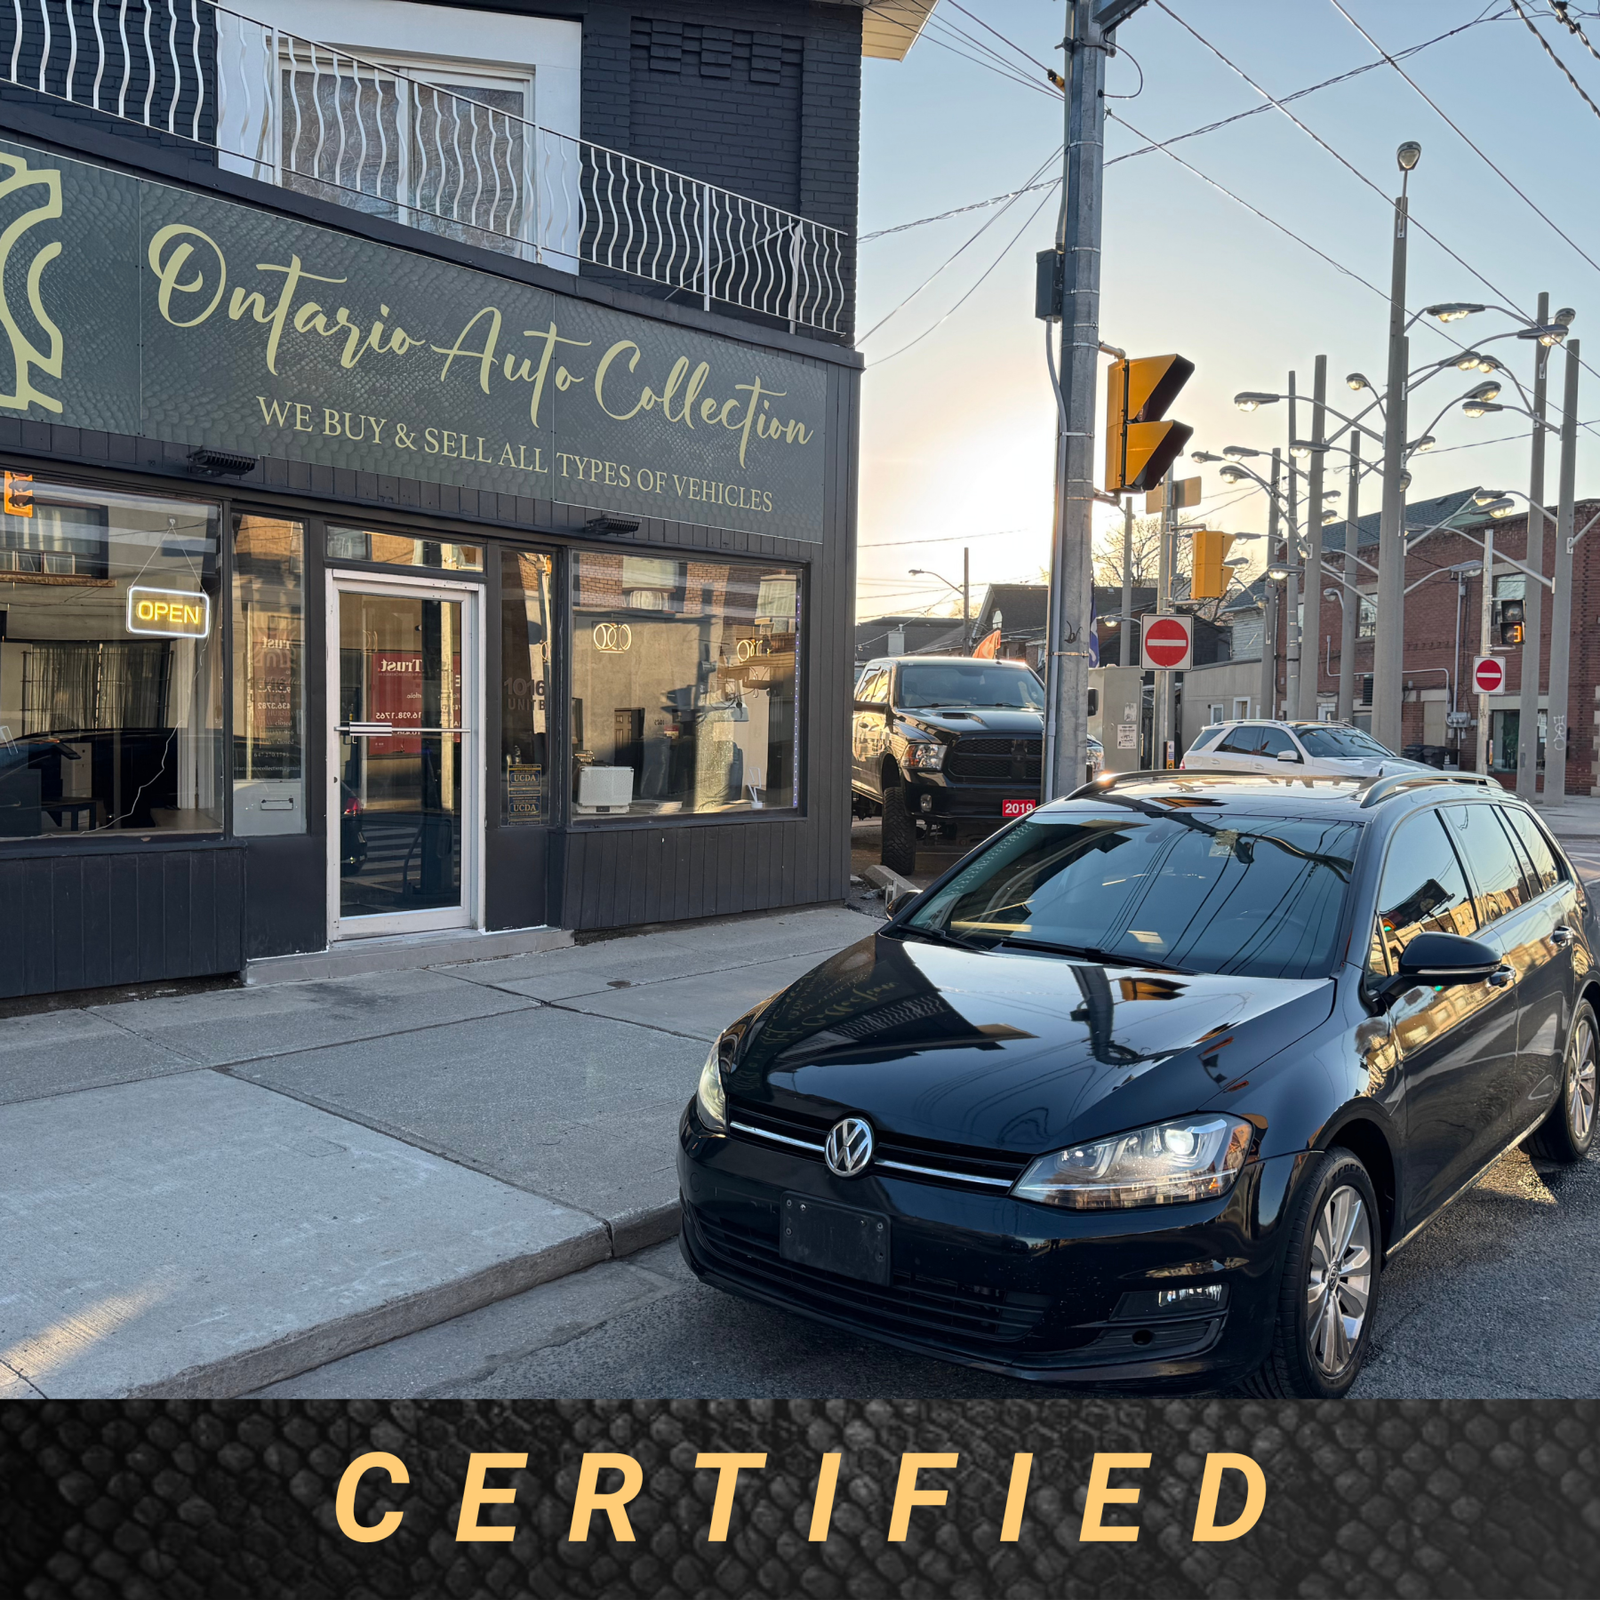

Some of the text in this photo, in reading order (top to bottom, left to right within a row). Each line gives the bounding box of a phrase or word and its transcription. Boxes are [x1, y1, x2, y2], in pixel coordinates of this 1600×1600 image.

[147, 223, 814, 469] Ontario Auto Collection
[256, 395, 774, 513] WE BUY & SELL ALL TYPES OF VEHICLES
[137, 600, 201, 625] OPEN
[503, 677, 546, 697] 1016
[507, 698, 546, 711] UNIT B
[513, 774, 537, 782] UCDA
[513, 804, 537, 812] UCDA
[1004, 802, 1034, 814] 2019
